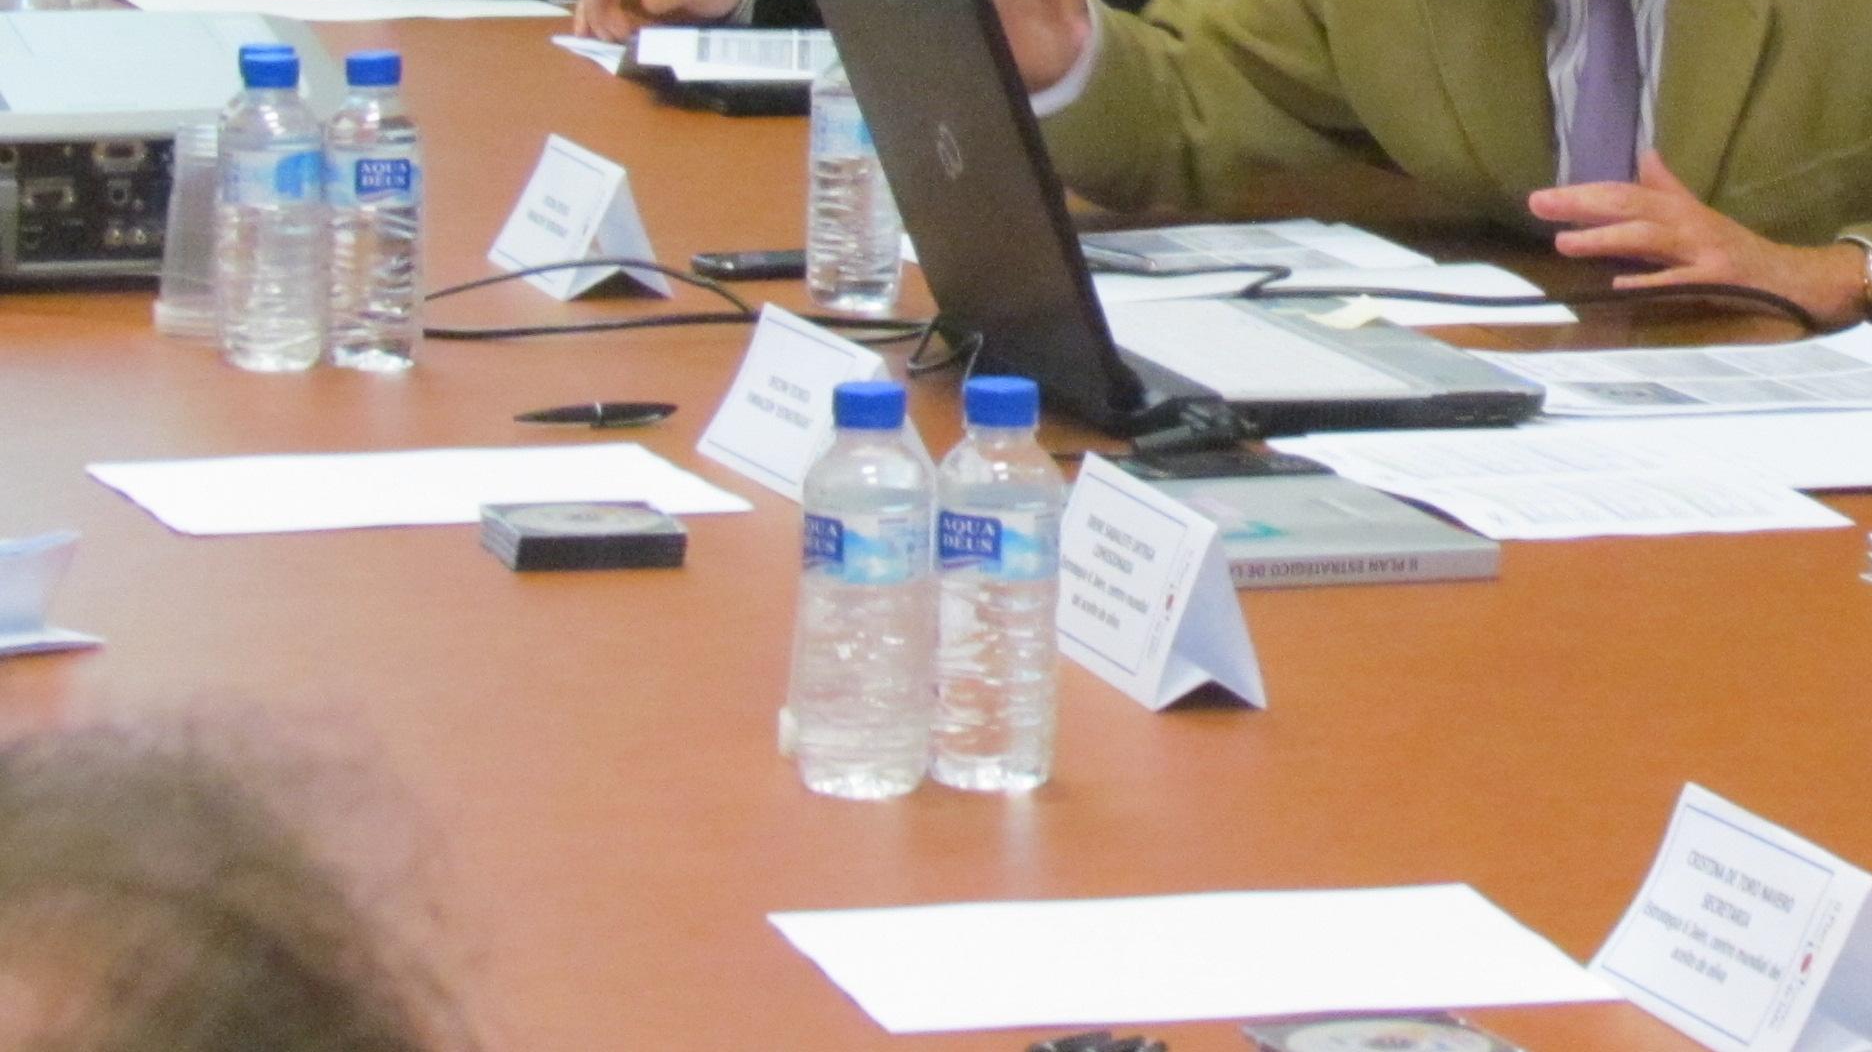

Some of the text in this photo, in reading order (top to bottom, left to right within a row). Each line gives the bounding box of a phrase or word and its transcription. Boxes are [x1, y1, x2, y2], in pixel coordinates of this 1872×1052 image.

[360, 160, 407, 174] AQUA
[943, 517, 996, 537] AQUA
[942, 535, 993, 553] DEUS
[1248, 563, 1266, 579] DE
[1368, 558, 1405, 575] PLAN
